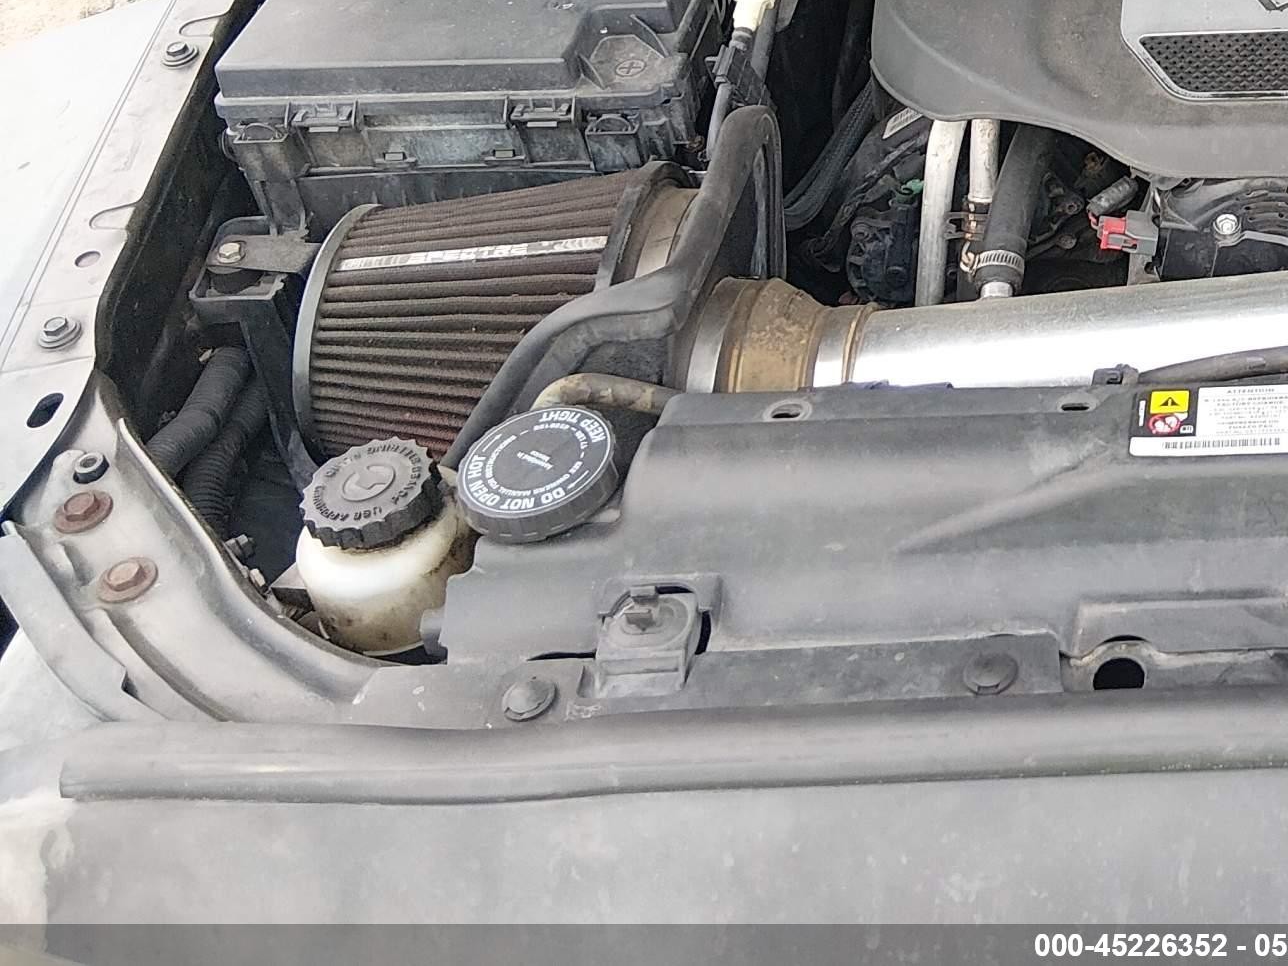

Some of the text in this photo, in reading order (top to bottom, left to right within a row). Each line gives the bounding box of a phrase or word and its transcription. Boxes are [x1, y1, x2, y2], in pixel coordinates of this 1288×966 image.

[538, 410, 581, 423] TIGHT
[579, 418, 607, 443] KEEP
[467, 454, 566, 510] DO NOT OPEN HOT
